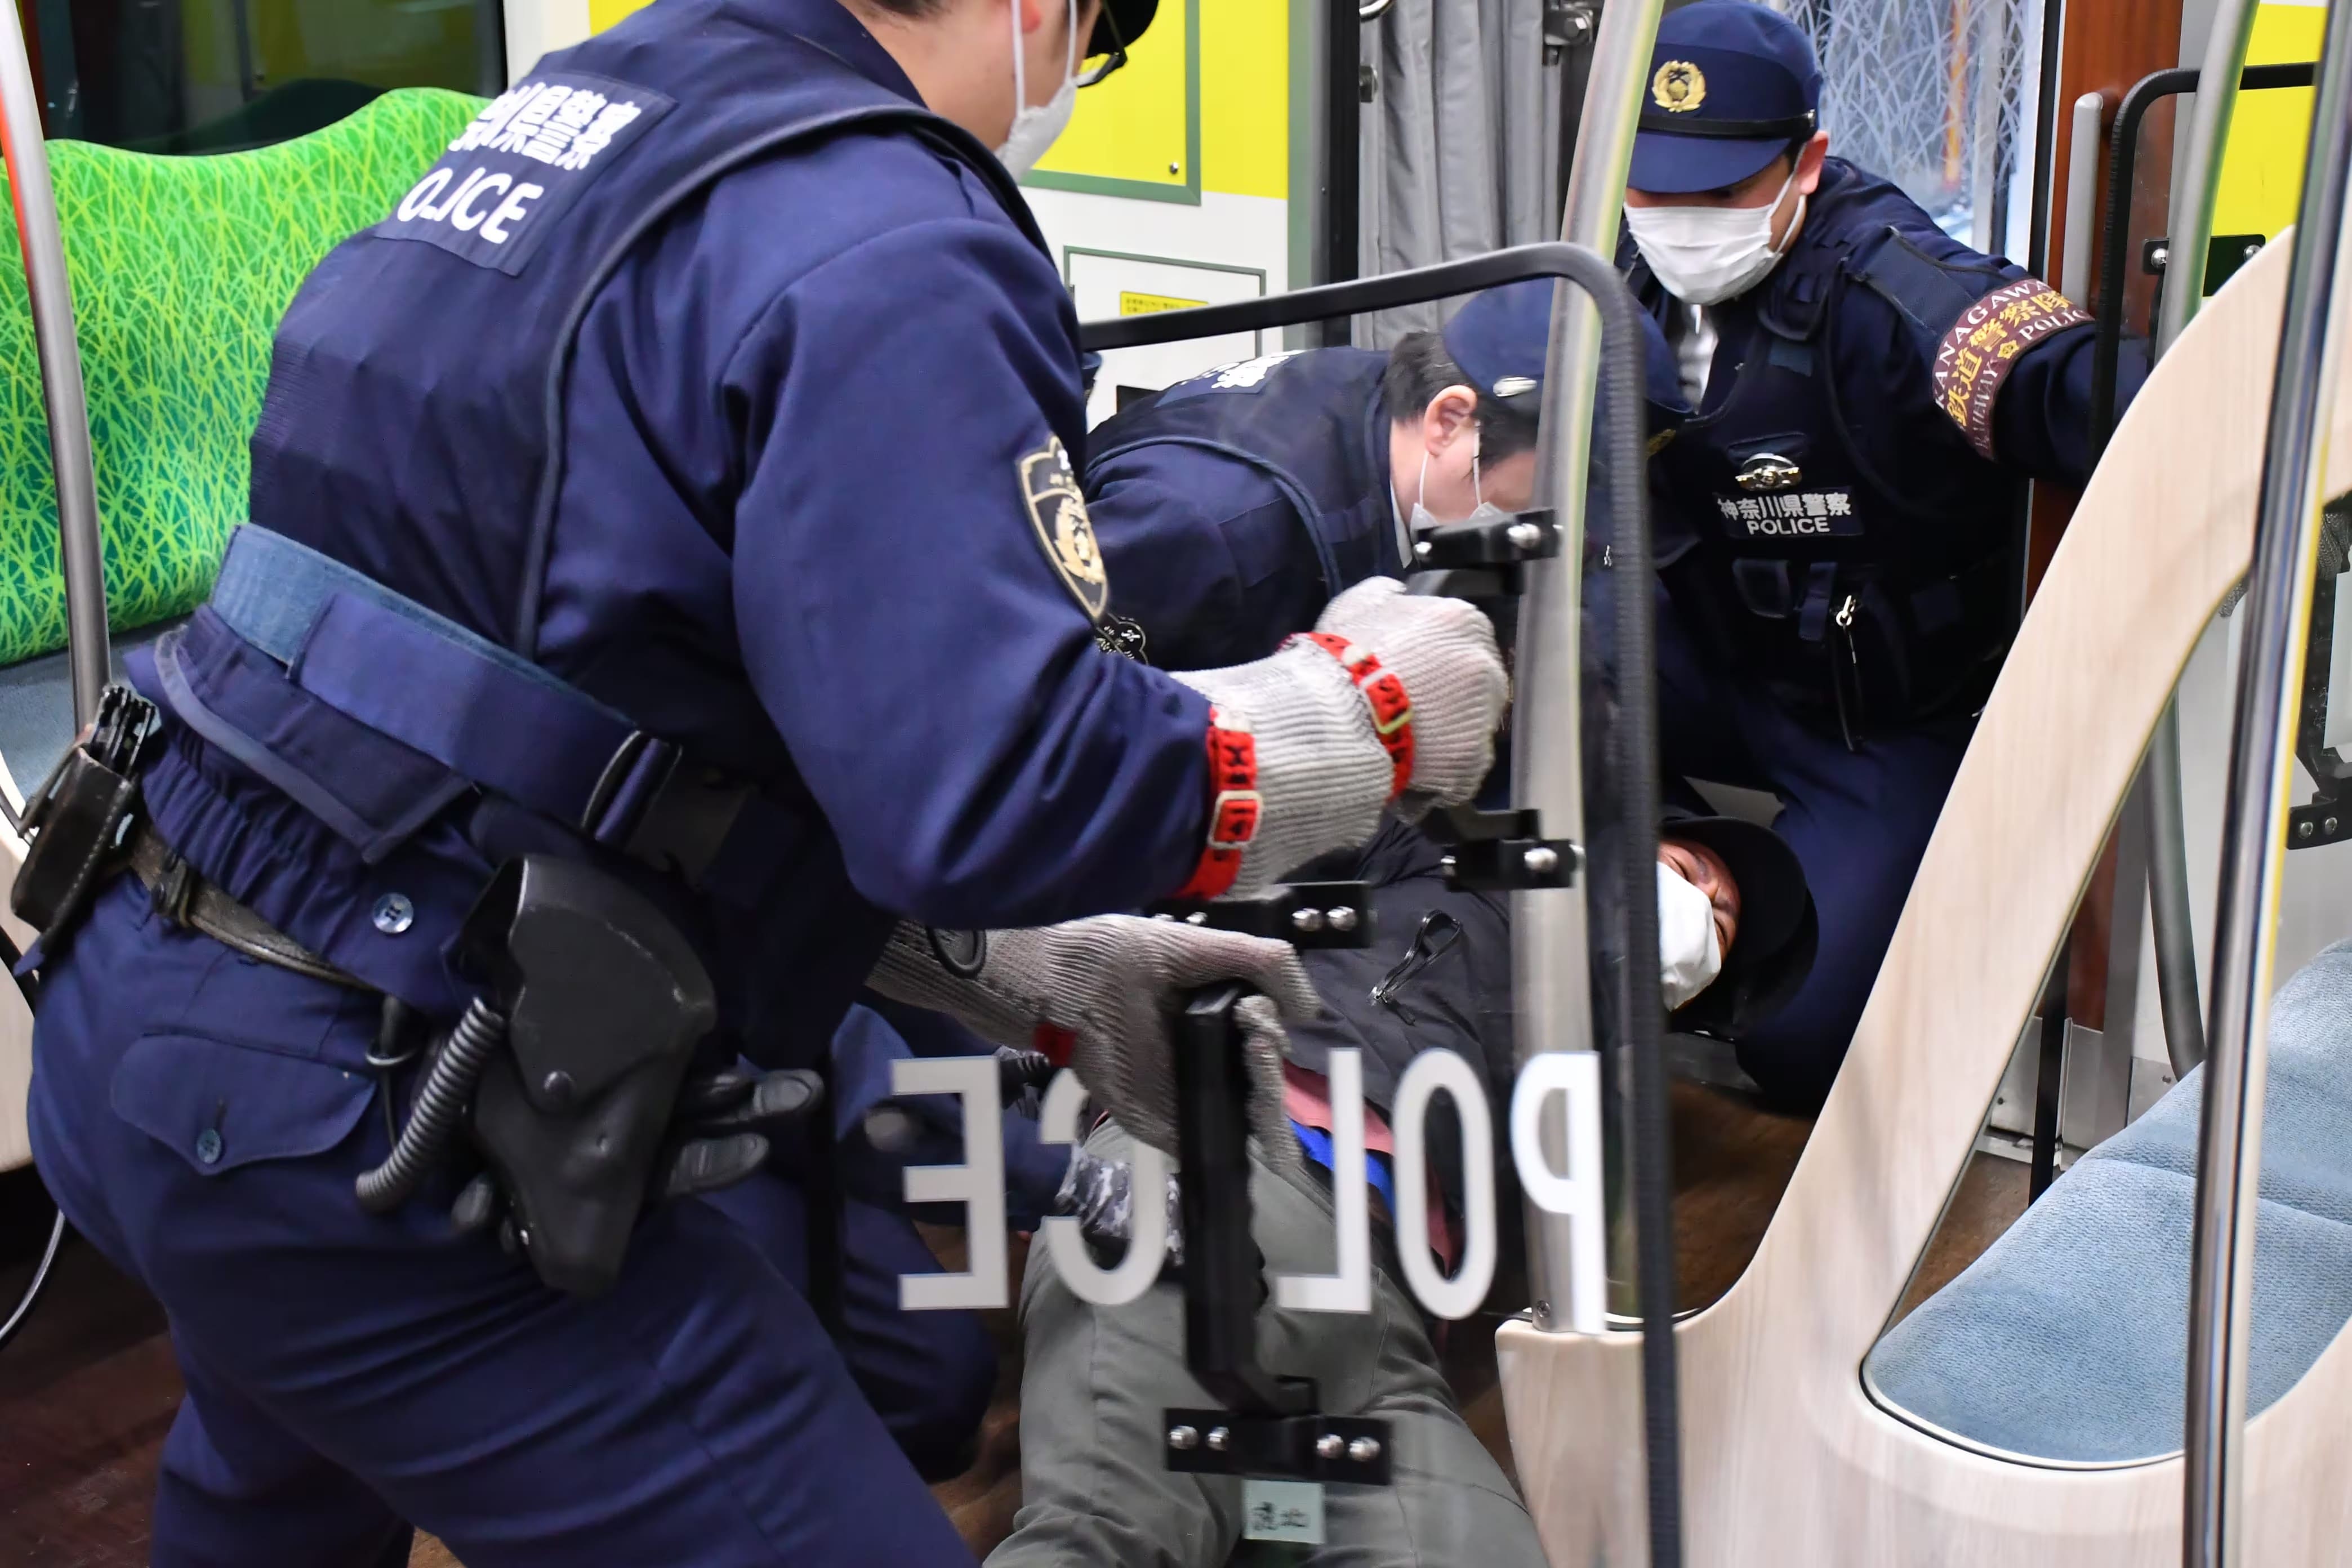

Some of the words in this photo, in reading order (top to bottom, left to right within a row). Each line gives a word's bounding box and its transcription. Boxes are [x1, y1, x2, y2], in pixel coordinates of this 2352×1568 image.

[397, 166, 545, 244] OICE
[1935, 280, 2050, 410] KANAGAWA
[2018, 309, 2087, 341] POLIC
[1946, 289, 2072, 426] 鉄道警察隊
[1717, 492, 1851, 521] 神奈川県警察
[1747, 516, 1830, 535] POLICE
